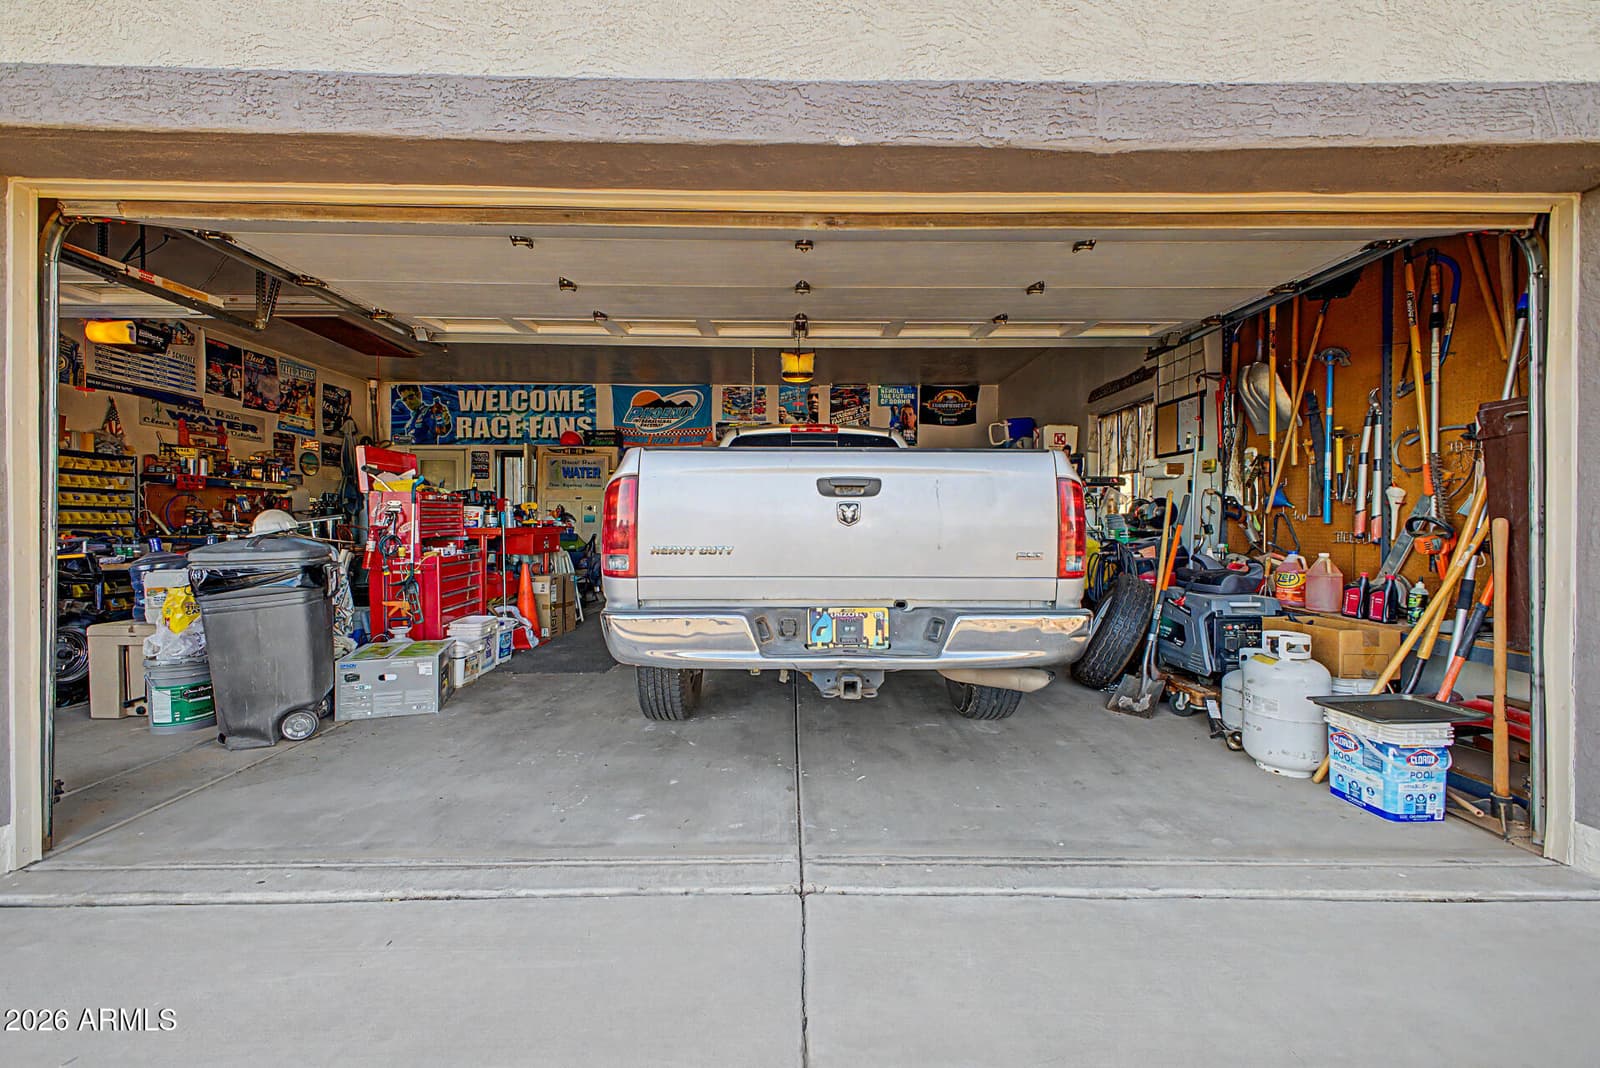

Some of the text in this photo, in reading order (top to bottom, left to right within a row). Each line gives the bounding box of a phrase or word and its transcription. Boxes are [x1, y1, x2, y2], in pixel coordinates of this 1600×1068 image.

[246, 352, 265, 364] Bud
[457, 389, 585, 412] WELCOME
[625, 406, 694, 421] PHOENIX
[166, 409, 258, 433] WATER
[456, 416, 524, 439] RACE
[529, 416, 593, 439] FANS
[562, 466, 601, 478] WATER
[650, 544, 735, 556] HEAVY DUTY
[1333, 749, 1356, 764] POOL
[1410, 755, 1435, 765] CLOROX
[1410, 771, 1435, 779] POOL
